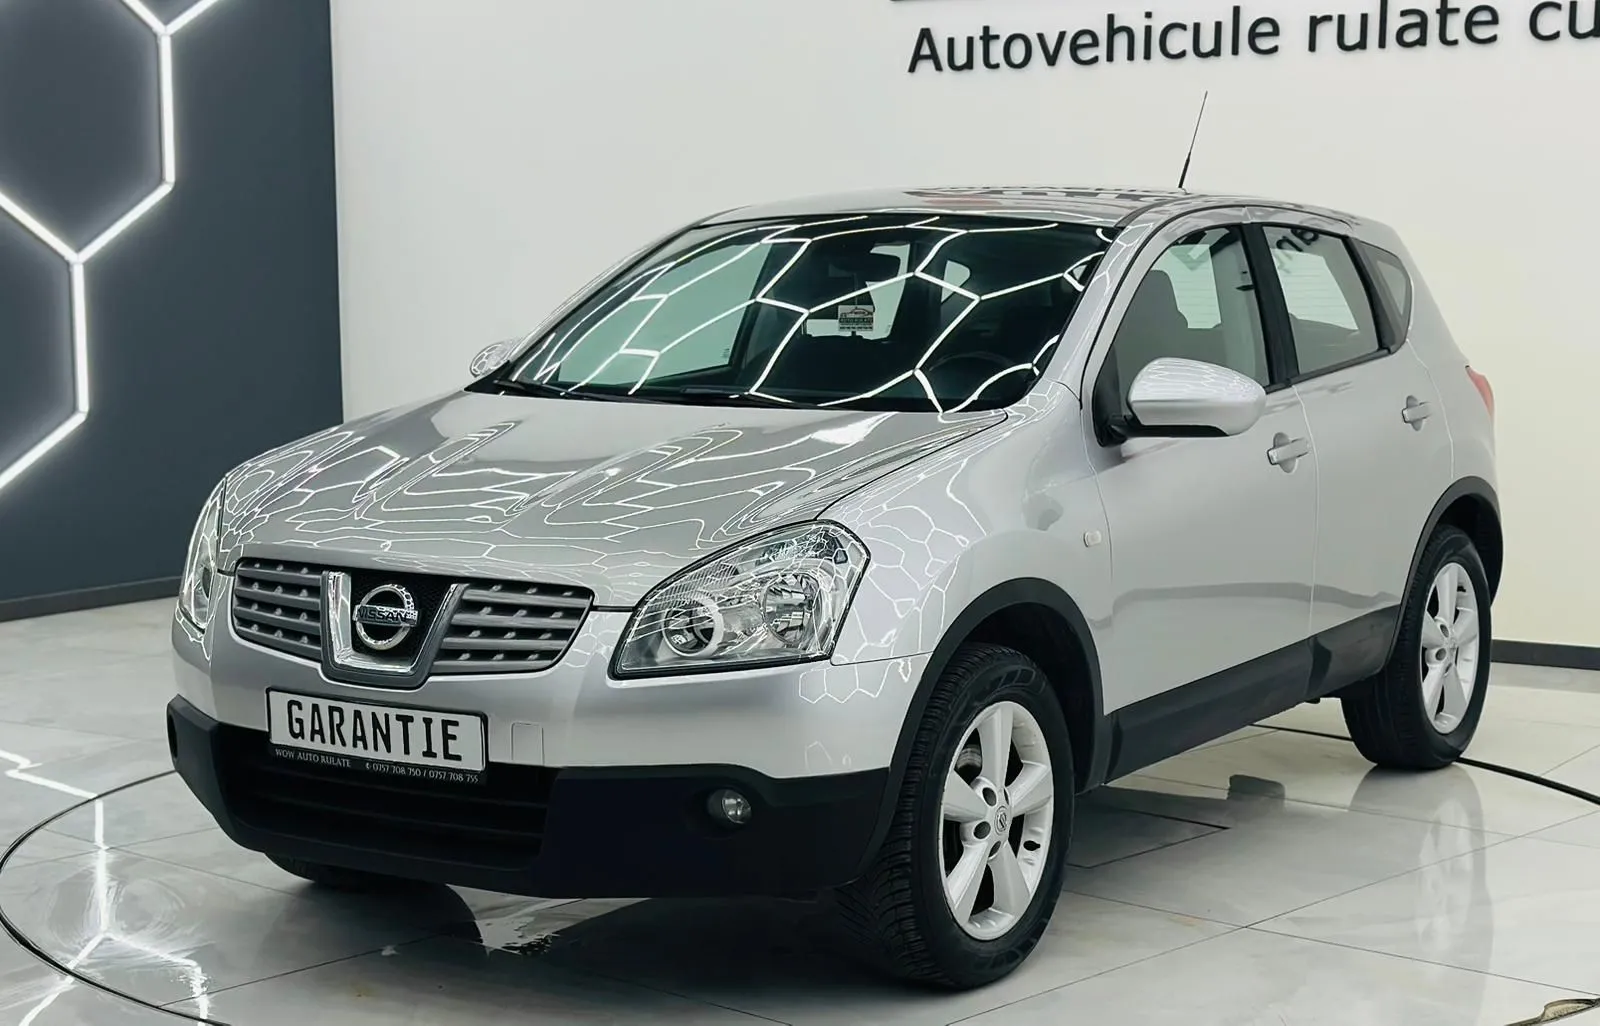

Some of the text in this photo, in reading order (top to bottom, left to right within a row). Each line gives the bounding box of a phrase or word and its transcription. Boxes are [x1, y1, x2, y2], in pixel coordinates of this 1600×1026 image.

[907, 0, 1600, 73] Autovehicule rulate cu
[358, 606, 408, 622] NISSAN
[287, 699, 463, 761] GARANTIE
[275, 748, 352, 768] WOW AUTO RULATE
[372, 762, 390, 773] 0757
[392, 765, 406, 775] 708
[407, 767, 421, 777] 750
[429, 770, 447, 780] 0757
[448, 772, 463, 782] 708
[466, 773, 479, 784] 755
